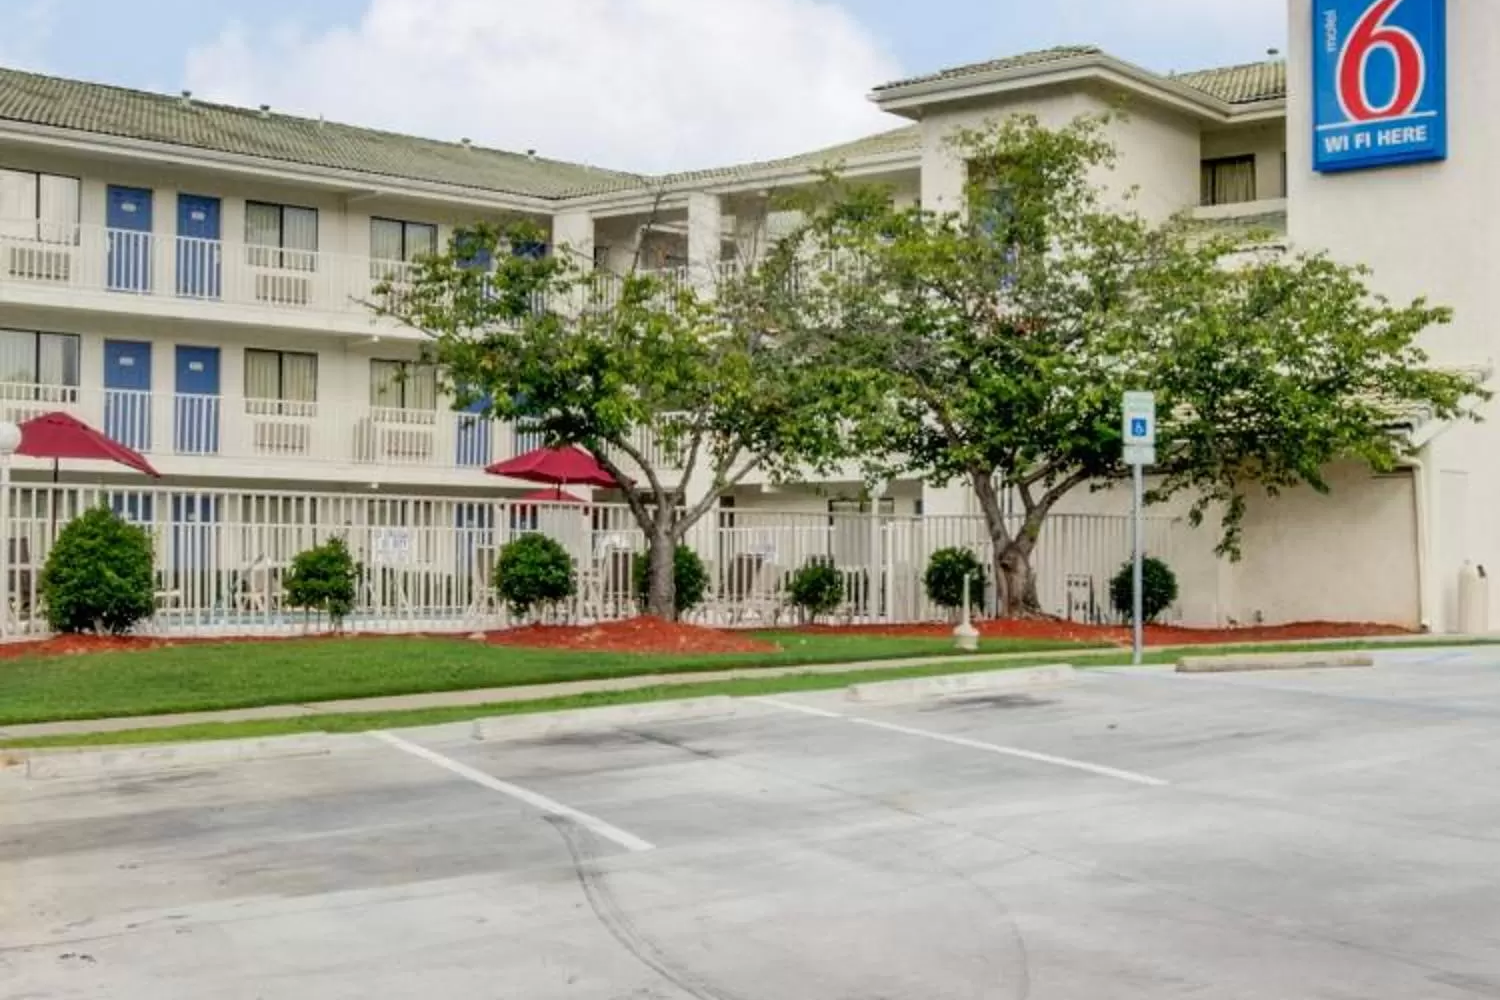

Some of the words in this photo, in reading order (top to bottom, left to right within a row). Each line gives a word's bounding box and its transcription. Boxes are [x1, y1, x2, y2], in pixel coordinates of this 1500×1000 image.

[1323, 9, 1337, 53] motel
[1325, 134, 1349, 153] WI
[1355, 131, 1371, 149] FI
[1377, 124, 1427, 146] HERE
